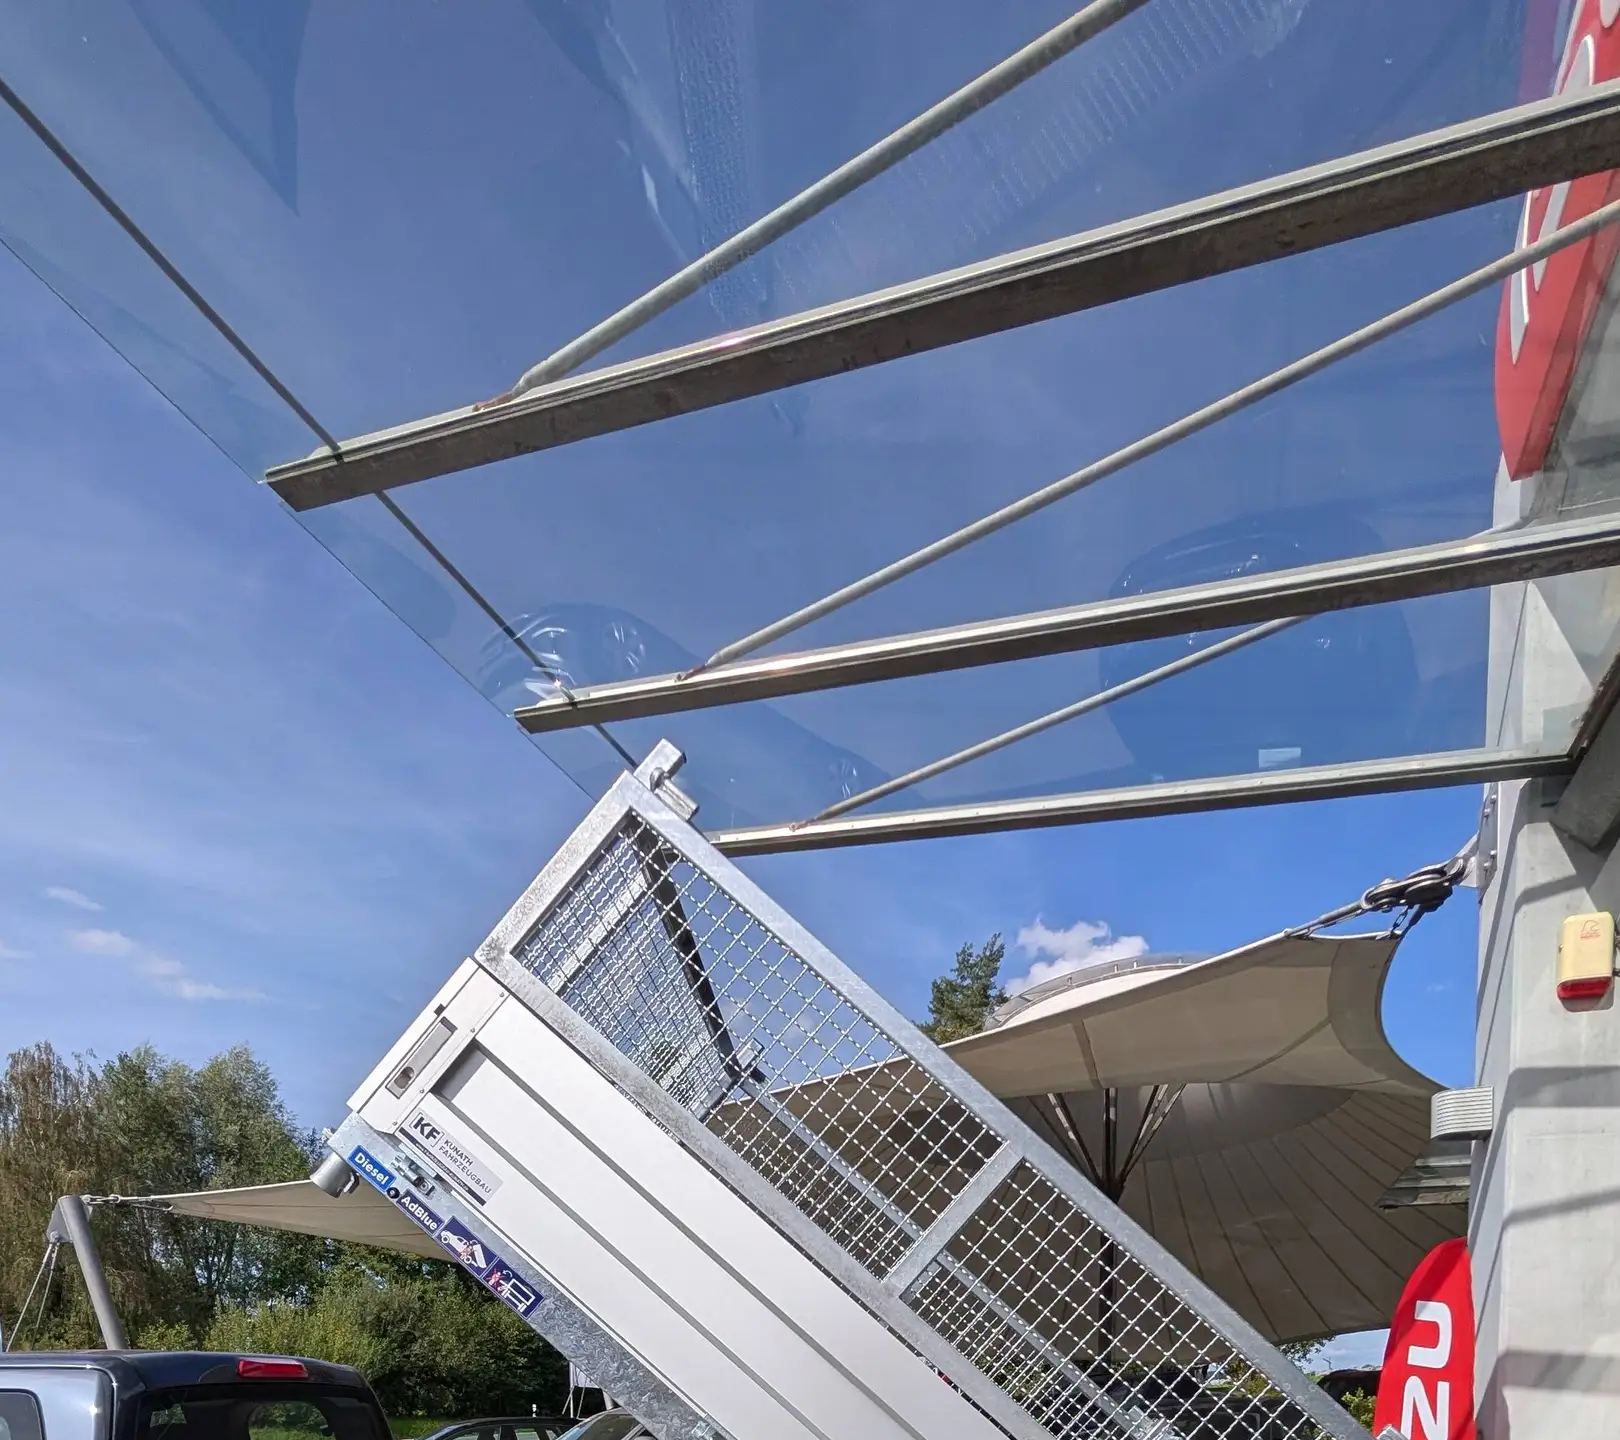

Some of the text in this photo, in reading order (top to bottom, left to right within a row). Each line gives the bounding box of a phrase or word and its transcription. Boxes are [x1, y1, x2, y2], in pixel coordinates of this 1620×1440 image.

[412, 1115, 442, 1145] KF
[354, 1152, 390, 1186] Diesel
[438, 1145, 493, 1195] FAHRZEUGBAU
[443, 1139, 474, 1167] KUNATH
[400, 1196, 438, 1231] AdBlue
